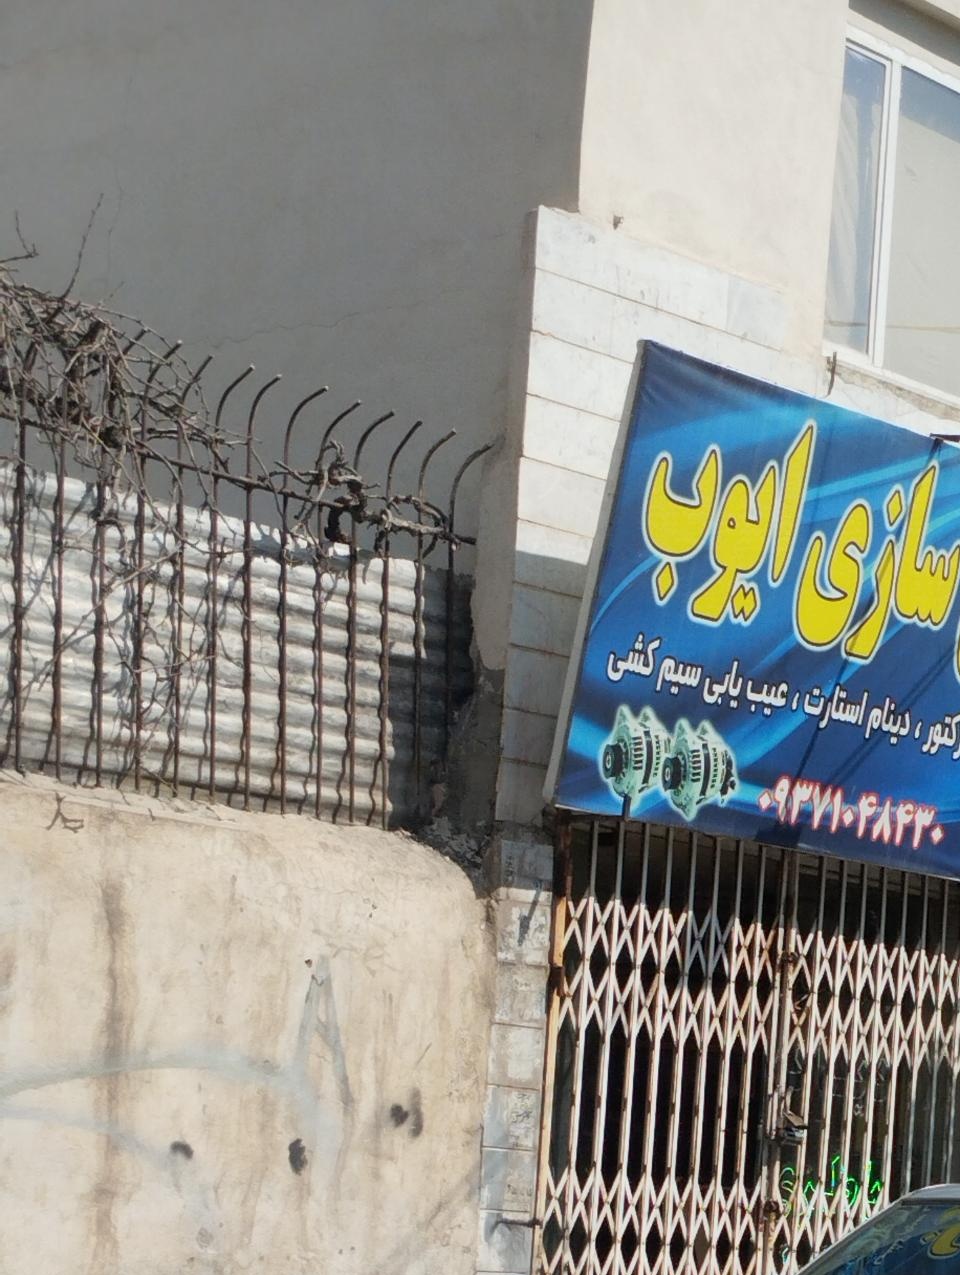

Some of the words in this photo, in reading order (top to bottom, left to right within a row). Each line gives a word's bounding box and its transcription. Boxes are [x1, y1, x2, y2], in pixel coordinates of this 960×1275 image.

[643, 420, 818, 625] ایوب
[606, 632, 661, 683] کشی
[655, 656, 702, 695] سیم
[702, 659, 743, 709] یابی
[746, 679, 790, 717] عیب
[803, 685, 868, 728] استارت
[864, 696, 911, 745] دینام
[757, 775, 945, 850] ۰۹۳۷۱۰۴۸۴۳۰
